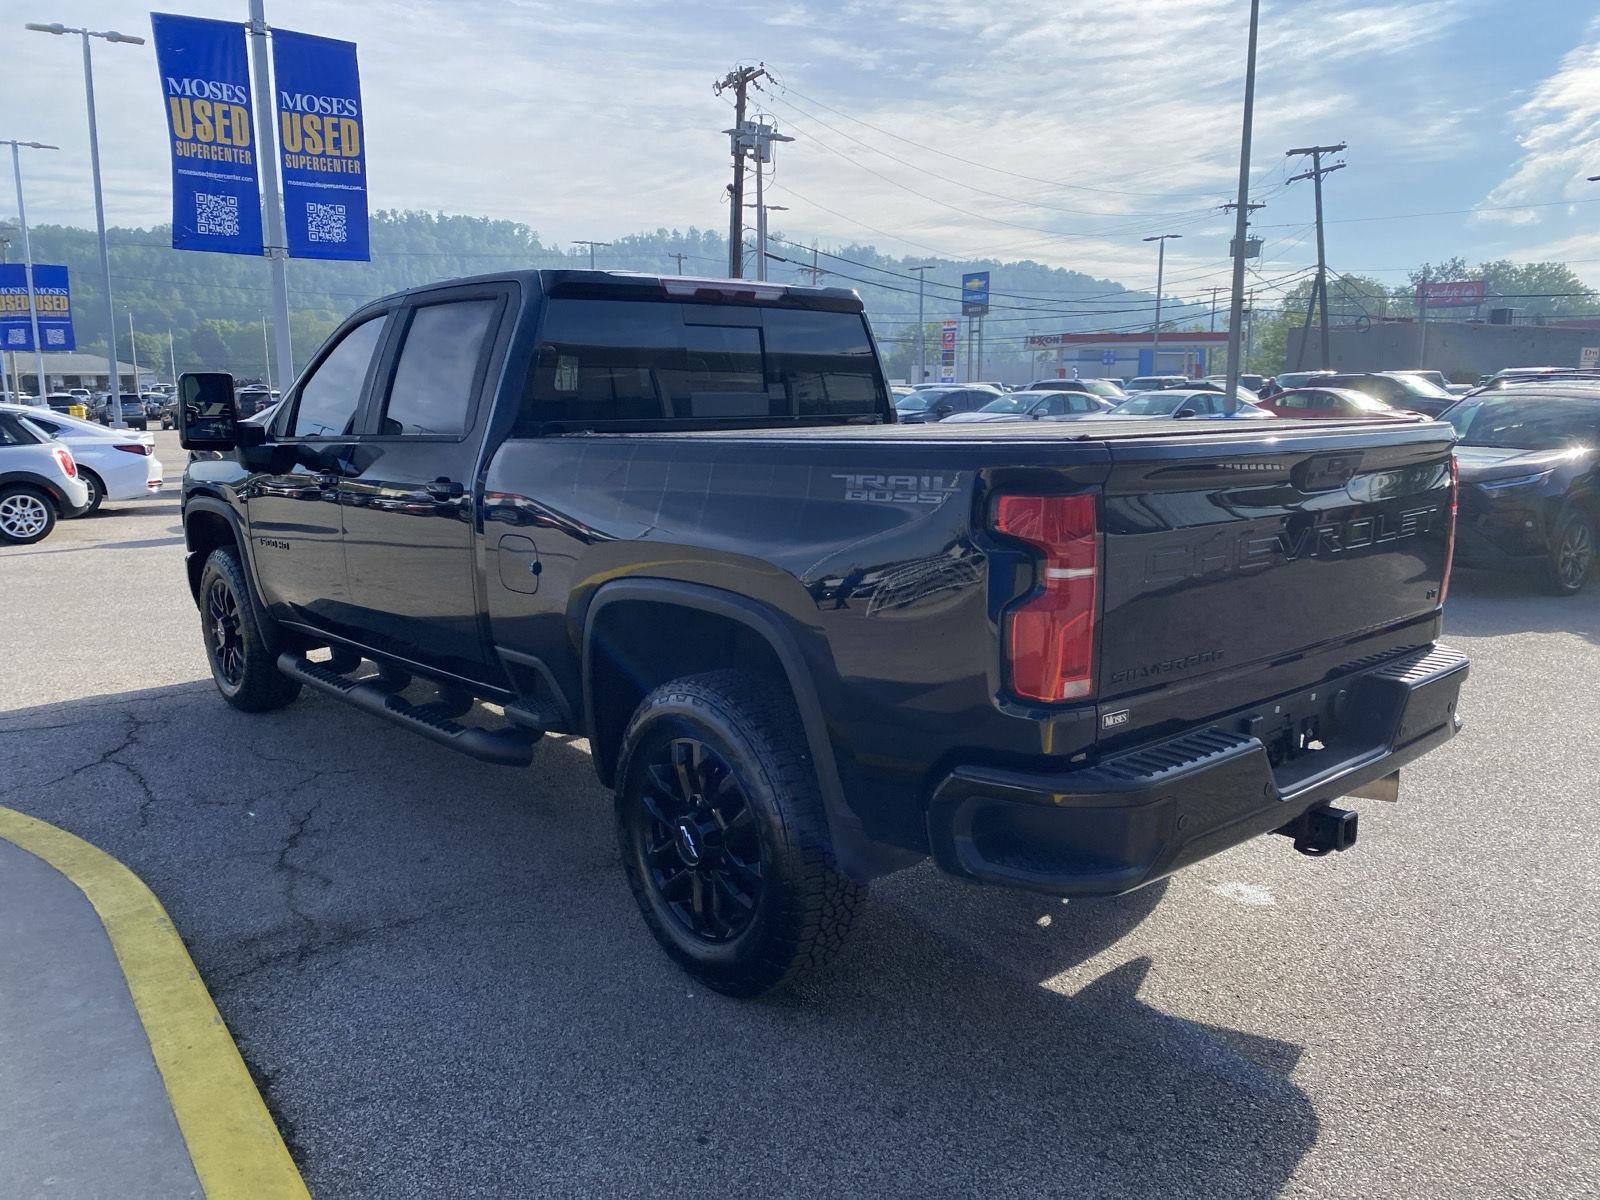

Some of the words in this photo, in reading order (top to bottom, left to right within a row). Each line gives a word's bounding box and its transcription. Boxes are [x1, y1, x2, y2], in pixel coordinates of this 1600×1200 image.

[166, 77, 247, 105] MOSES
[280, 91, 358, 116] MOSES
[169, 97, 251, 147] USED
[282, 111, 361, 157] USED
[176, 140, 253, 165] SUPERCENTER
[285, 153, 361, 175] SUPERCENTER
[35, 287, 68, 296] MOSES
[35, 295, 69, 311] USED
[1029, 335, 1061, 347] EXXON
[831, 474, 961, 491] TRAIL
[845, 489, 943, 504] BOSS
[1143, 503, 1439, 585] CHEVROLET
